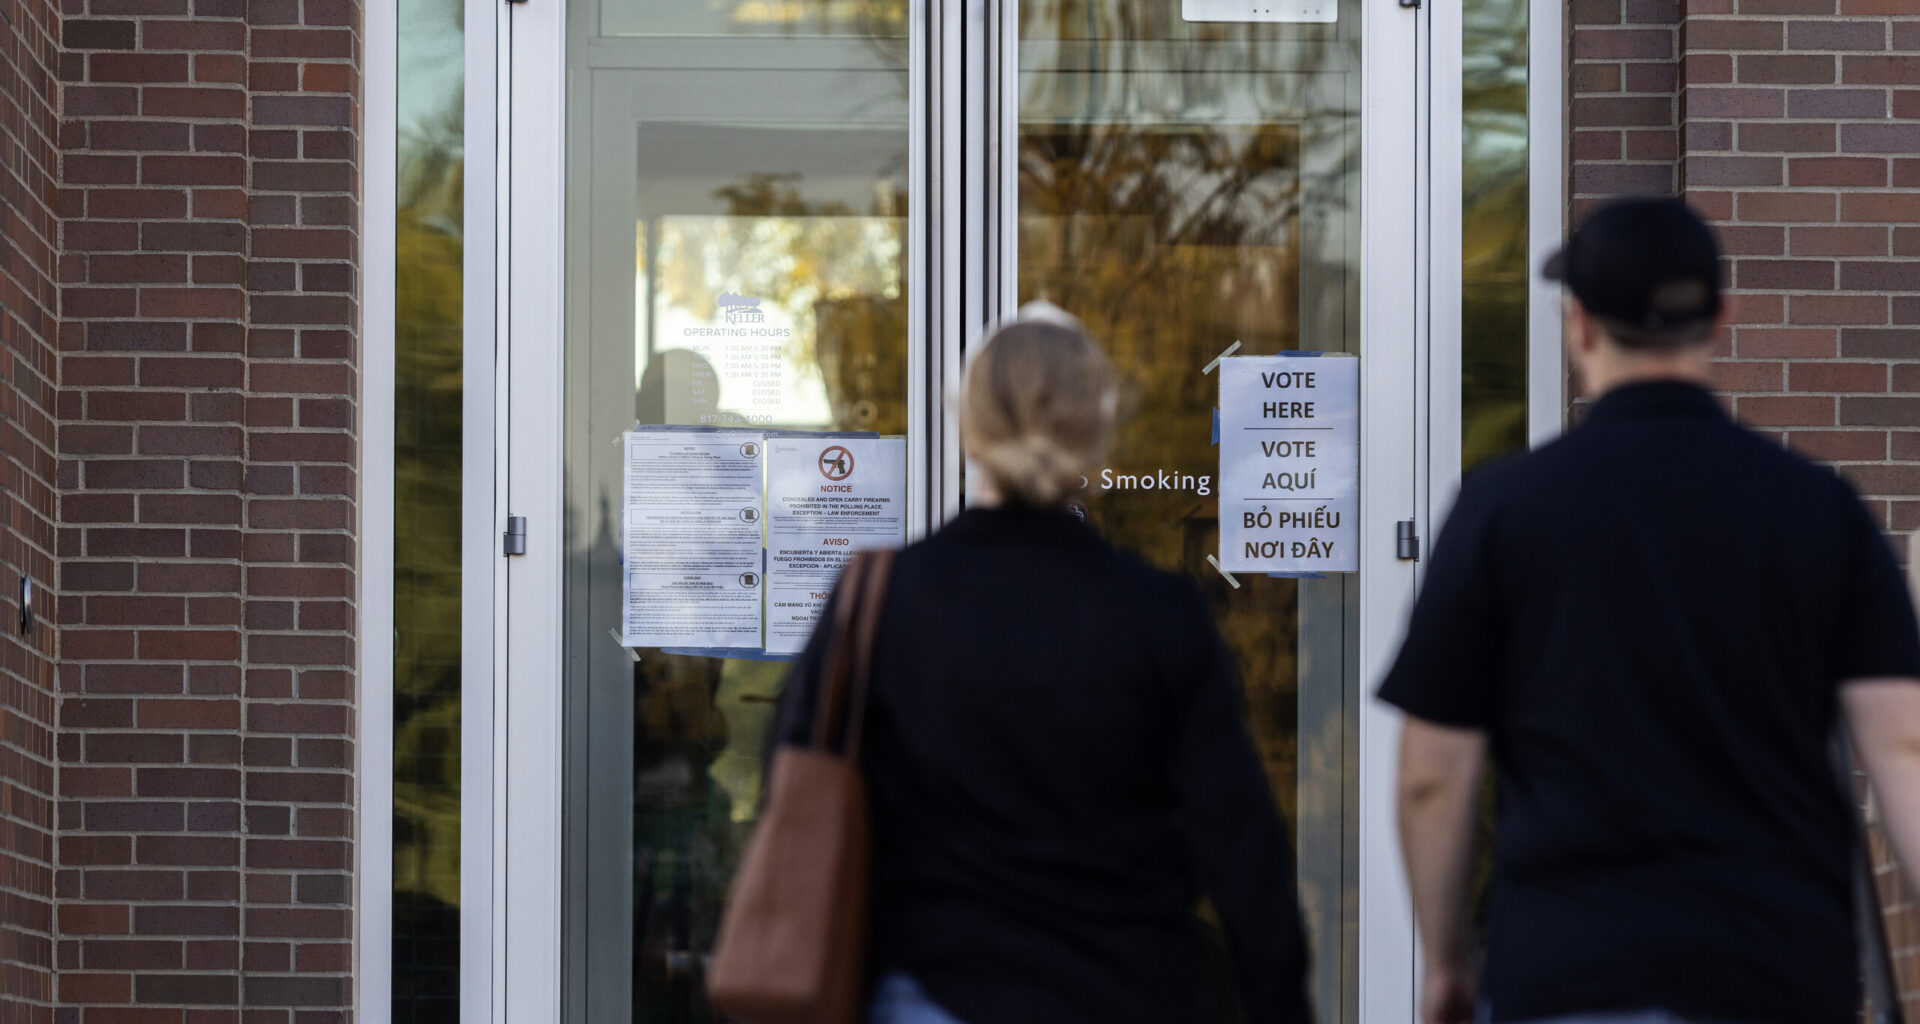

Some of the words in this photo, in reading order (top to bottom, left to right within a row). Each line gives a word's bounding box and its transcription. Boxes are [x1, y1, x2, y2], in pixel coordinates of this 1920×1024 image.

[725, 313, 765, 325] KELLER
[683, 328, 747, 337] OPERATING
[750, 328, 791, 337] HOURS
[1261, 372, 1316, 388] VOTE
[1263, 402, 1315, 418] HERE
[1261, 441, 1316, 457] VOTE
[1101, 469, 1211, 496] Smoking
[1261, 468, 1317, 491] AQUÍ
[820, 485, 852, 493] NOTICE
[1243, 505, 1272, 529] BỎ
[1279, 505, 1340, 529] PHIẾU
[823, 538, 849, 546] AVISO
[1245, 540, 1285, 558] NƠI
[1291, 537, 1334, 558] ĐÂY
